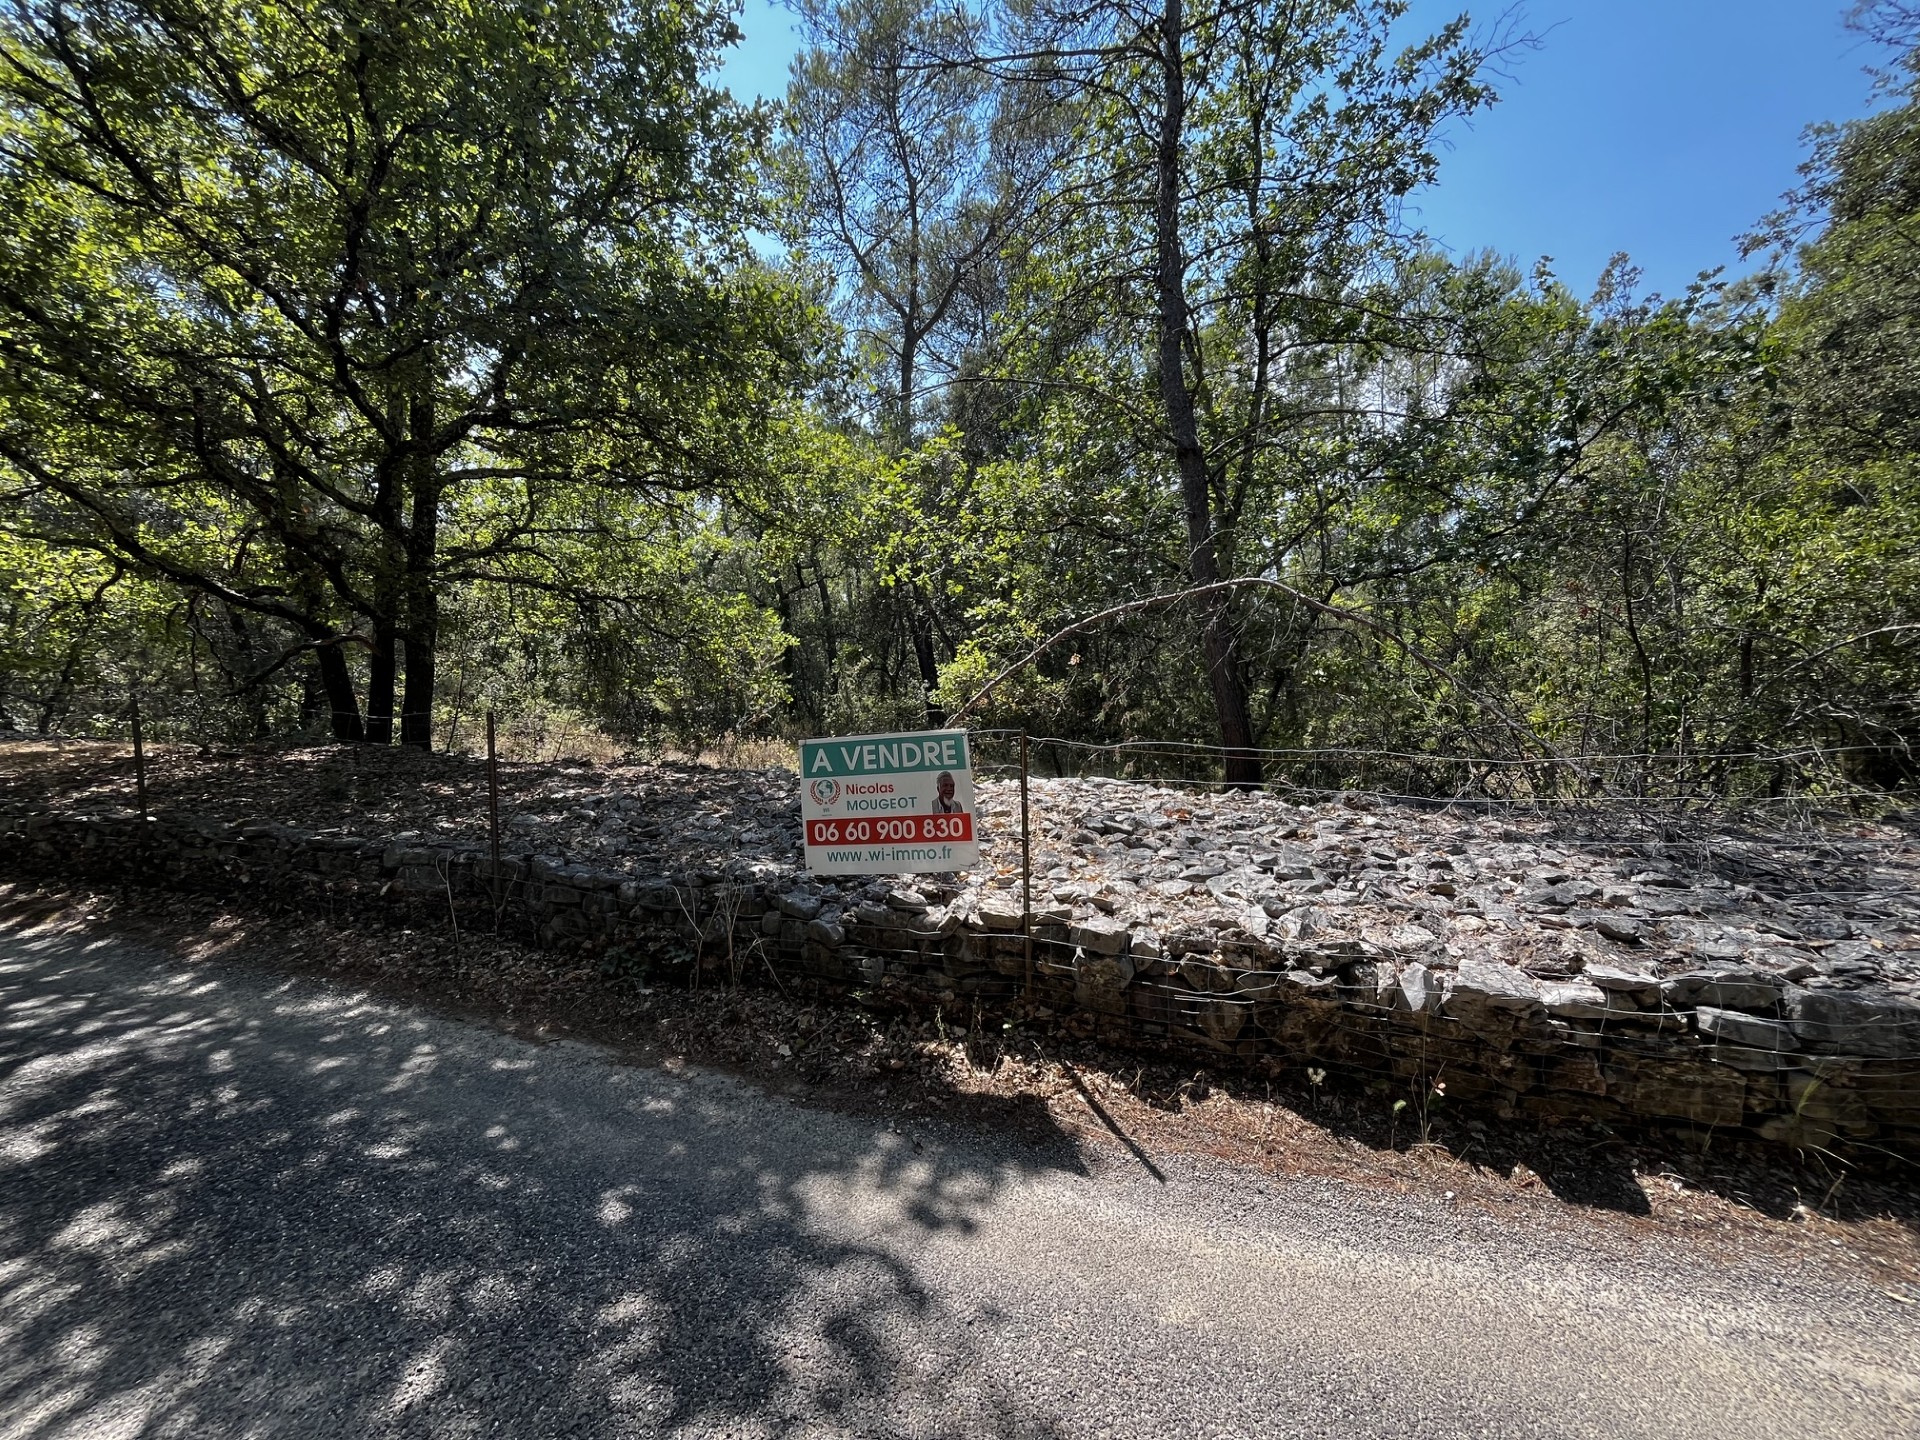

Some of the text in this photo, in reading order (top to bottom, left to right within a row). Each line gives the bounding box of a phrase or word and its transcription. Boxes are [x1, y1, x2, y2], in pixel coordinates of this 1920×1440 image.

[811, 739, 957, 773] A VENDRE
[846, 782, 894, 795] Nicolas
[846, 796, 917, 811] MOUGEOT
[814, 817, 963, 842] 06 60 900 830
[827, 845, 952, 863] www.wi-immo.fr
